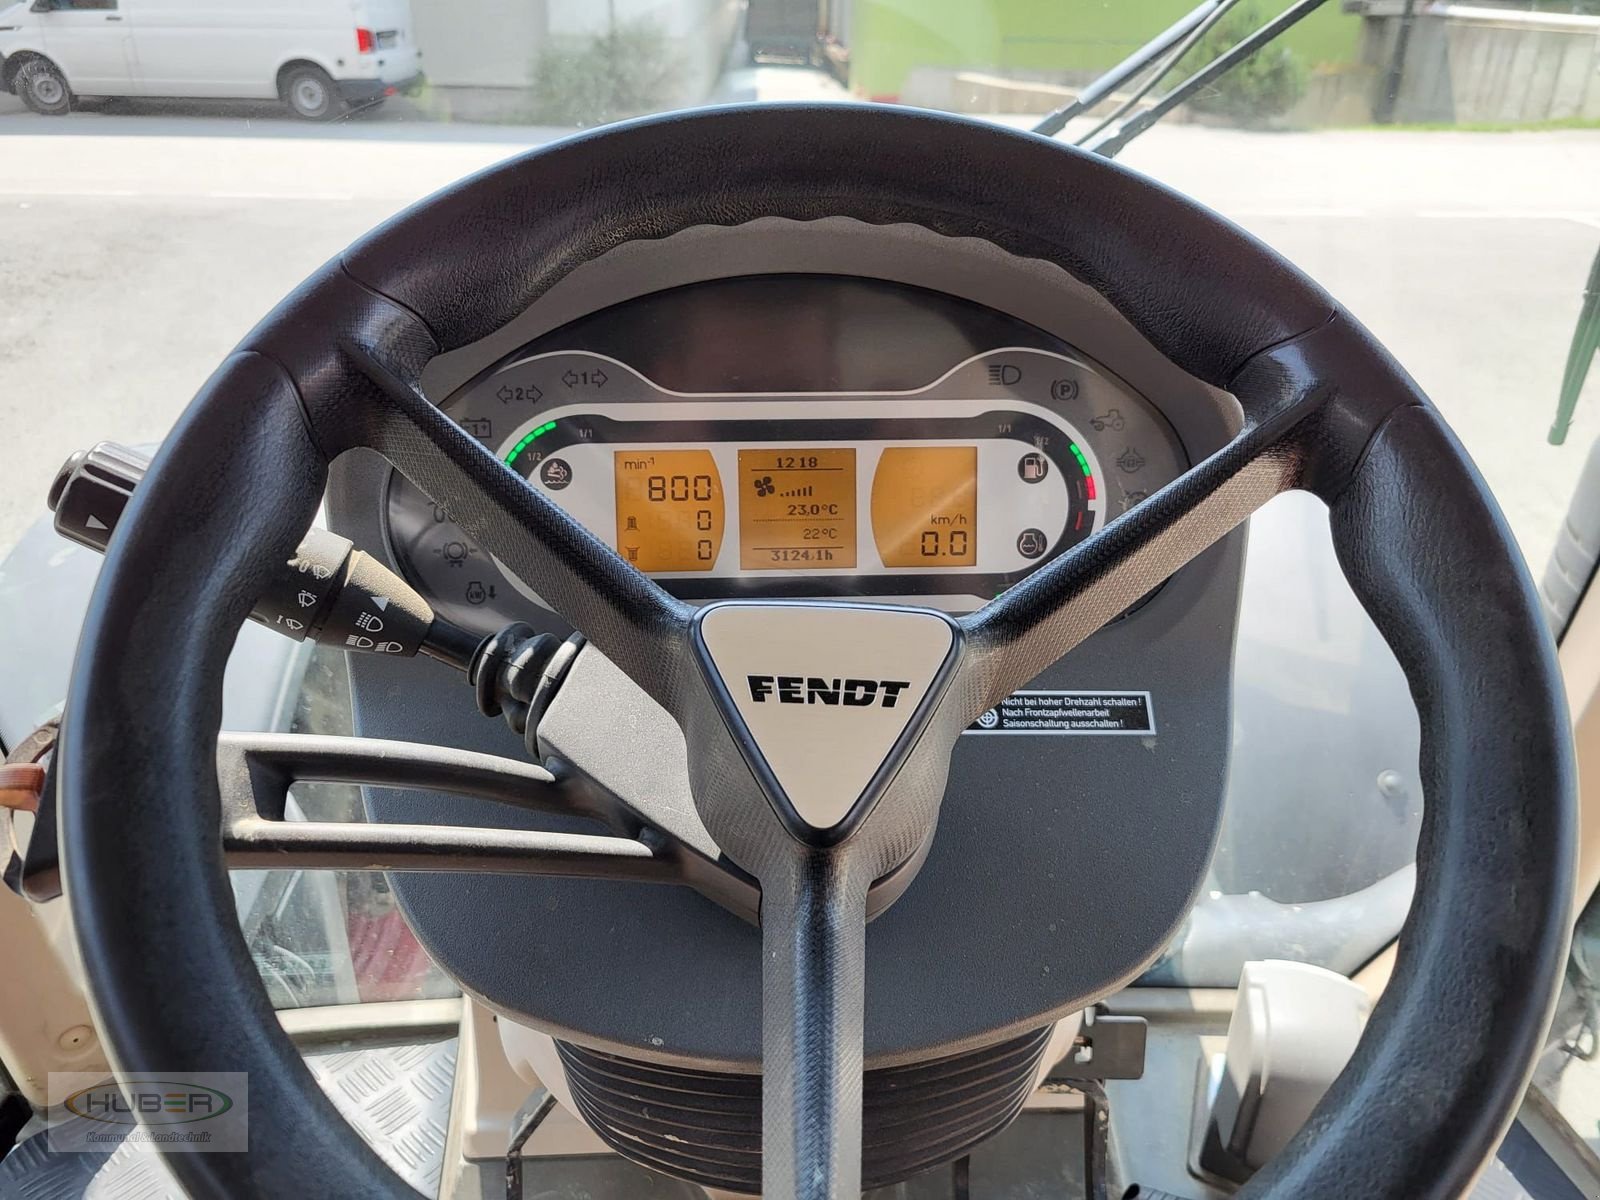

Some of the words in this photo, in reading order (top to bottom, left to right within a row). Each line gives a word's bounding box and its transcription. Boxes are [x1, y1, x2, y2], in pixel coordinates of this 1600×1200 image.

[515, 387, 524, 401] 2
[579, 428, 593, 438] 1/1
[648, 475, 711, 502] 800
[697, 510, 711, 531] 0
[930, 513, 967, 527] km/h
[698, 539, 712, 560] 0
[921, 530, 967, 556] 0.0
[747, 675, 910, 708] FENDT
[1001, 697, 1023, 706] Nicht
[1024, 697, 1037, 706] bei
[1038, 697, 1063, 706] hoher
[1064, 697, 1102, 706] Drehzahl
[1002, 708, 1024, 717] Nach
[1024, 708, 1110, 718] Frontzapfwellenarbeit
[1003, 719, 1070, 730] Saisonschaltung
